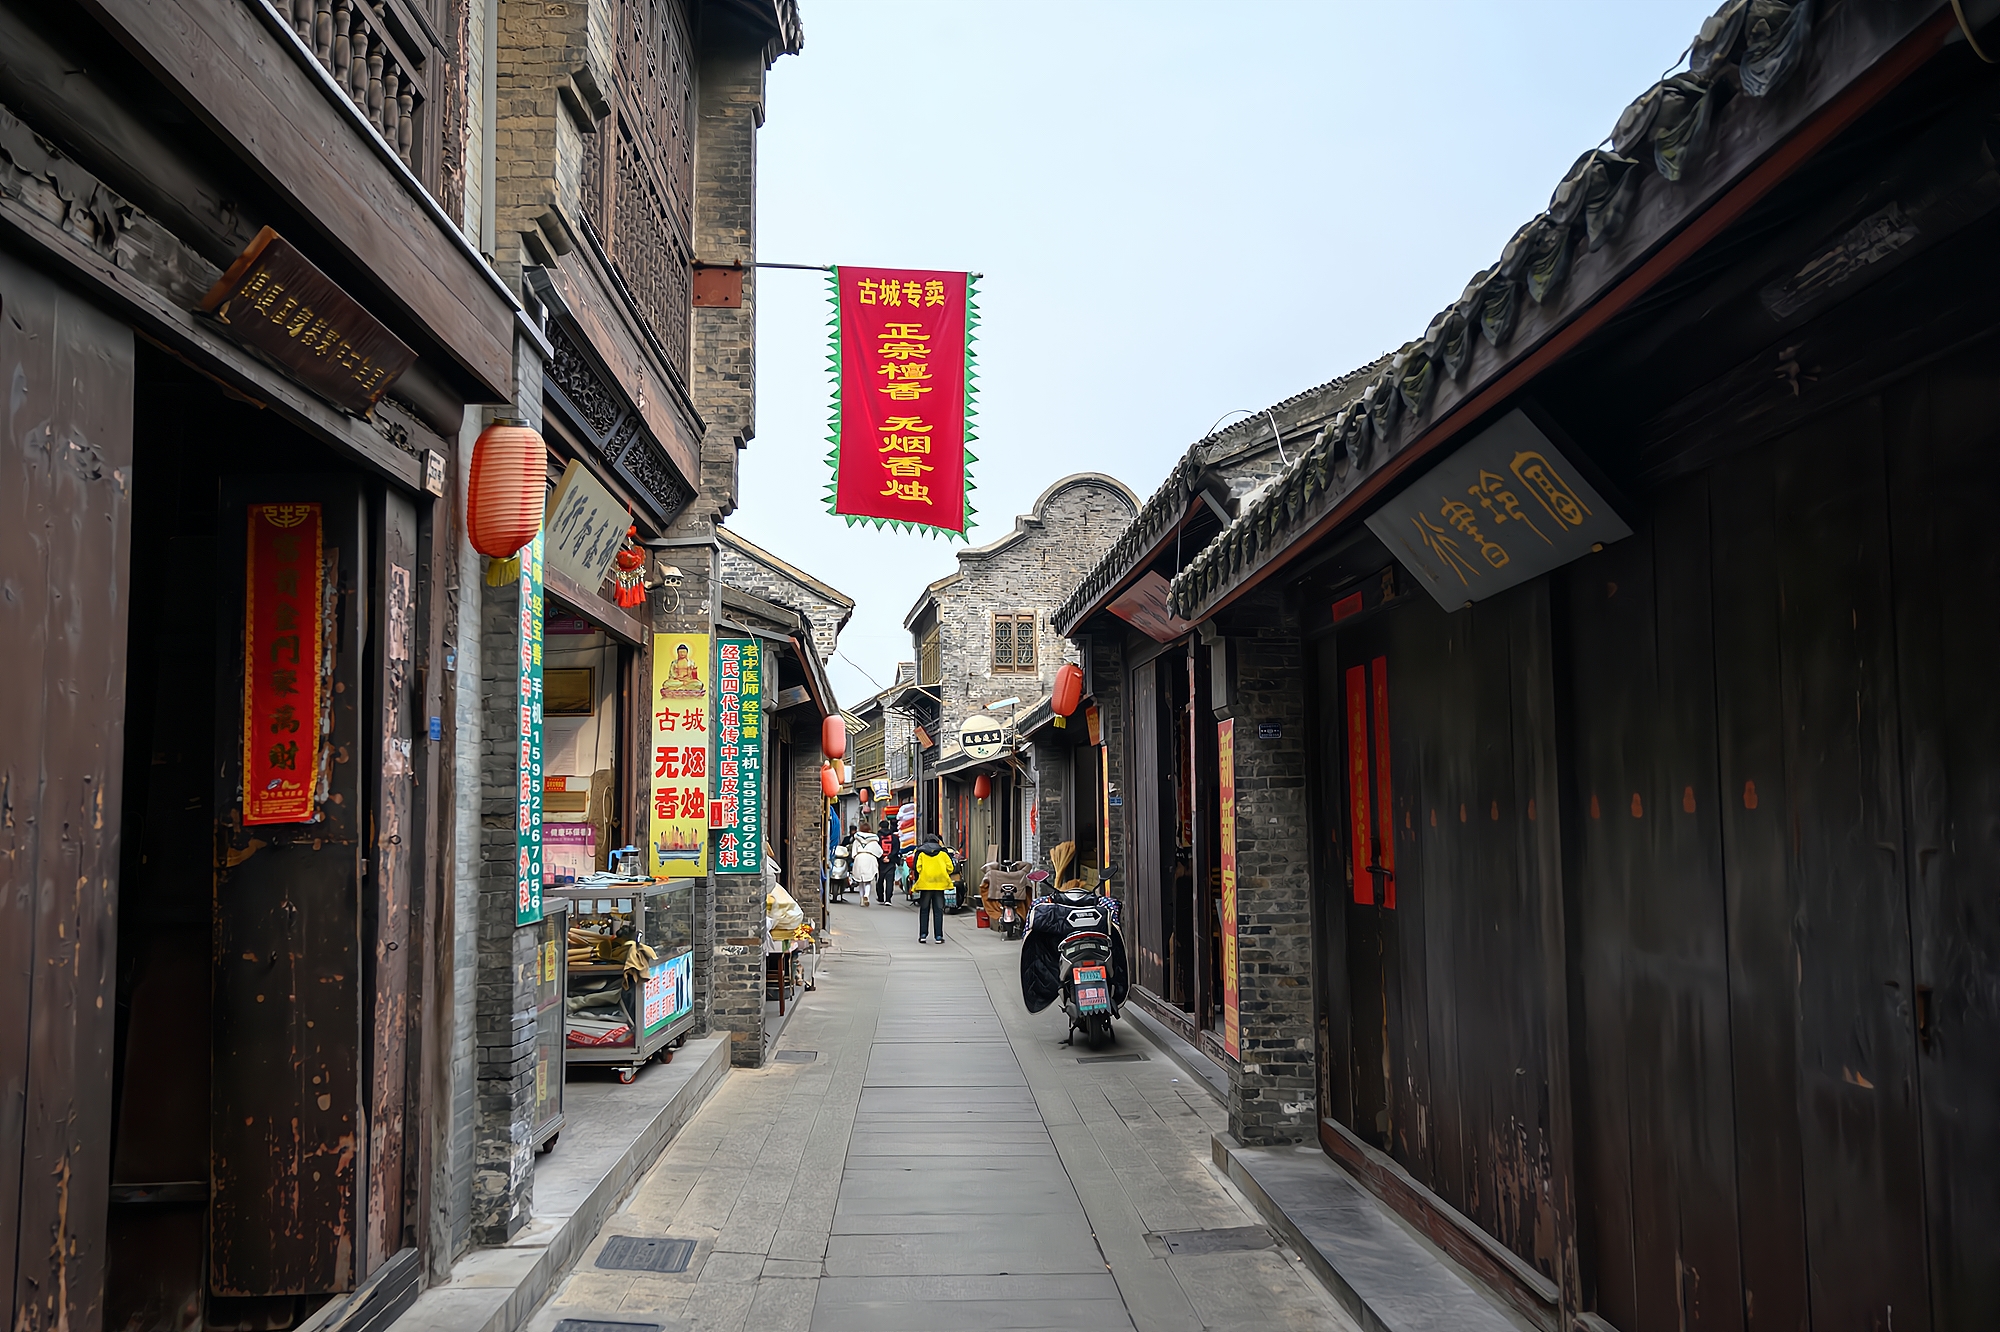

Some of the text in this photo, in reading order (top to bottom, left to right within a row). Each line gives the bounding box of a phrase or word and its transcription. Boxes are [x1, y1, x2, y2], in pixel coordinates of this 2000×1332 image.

[858, 278, 945, 308] 古城专卖
[877, 322, 935, 506] 正宗檀香 无烟香烛
[741, 644, 760, 696] 老中医师
[518, 545, 533, 914] 四代祖传中医皮肤科 外科
[655, 706, 707, 732] 古城
[741, 700, 760, 739] 经宝善
[655, 746, 706, 779] 无烟
[654, 786, 705, 820] 香烛
[720, 833, 739, 868] 外科
[1218, 728, 1238, 997] 新新家俱
